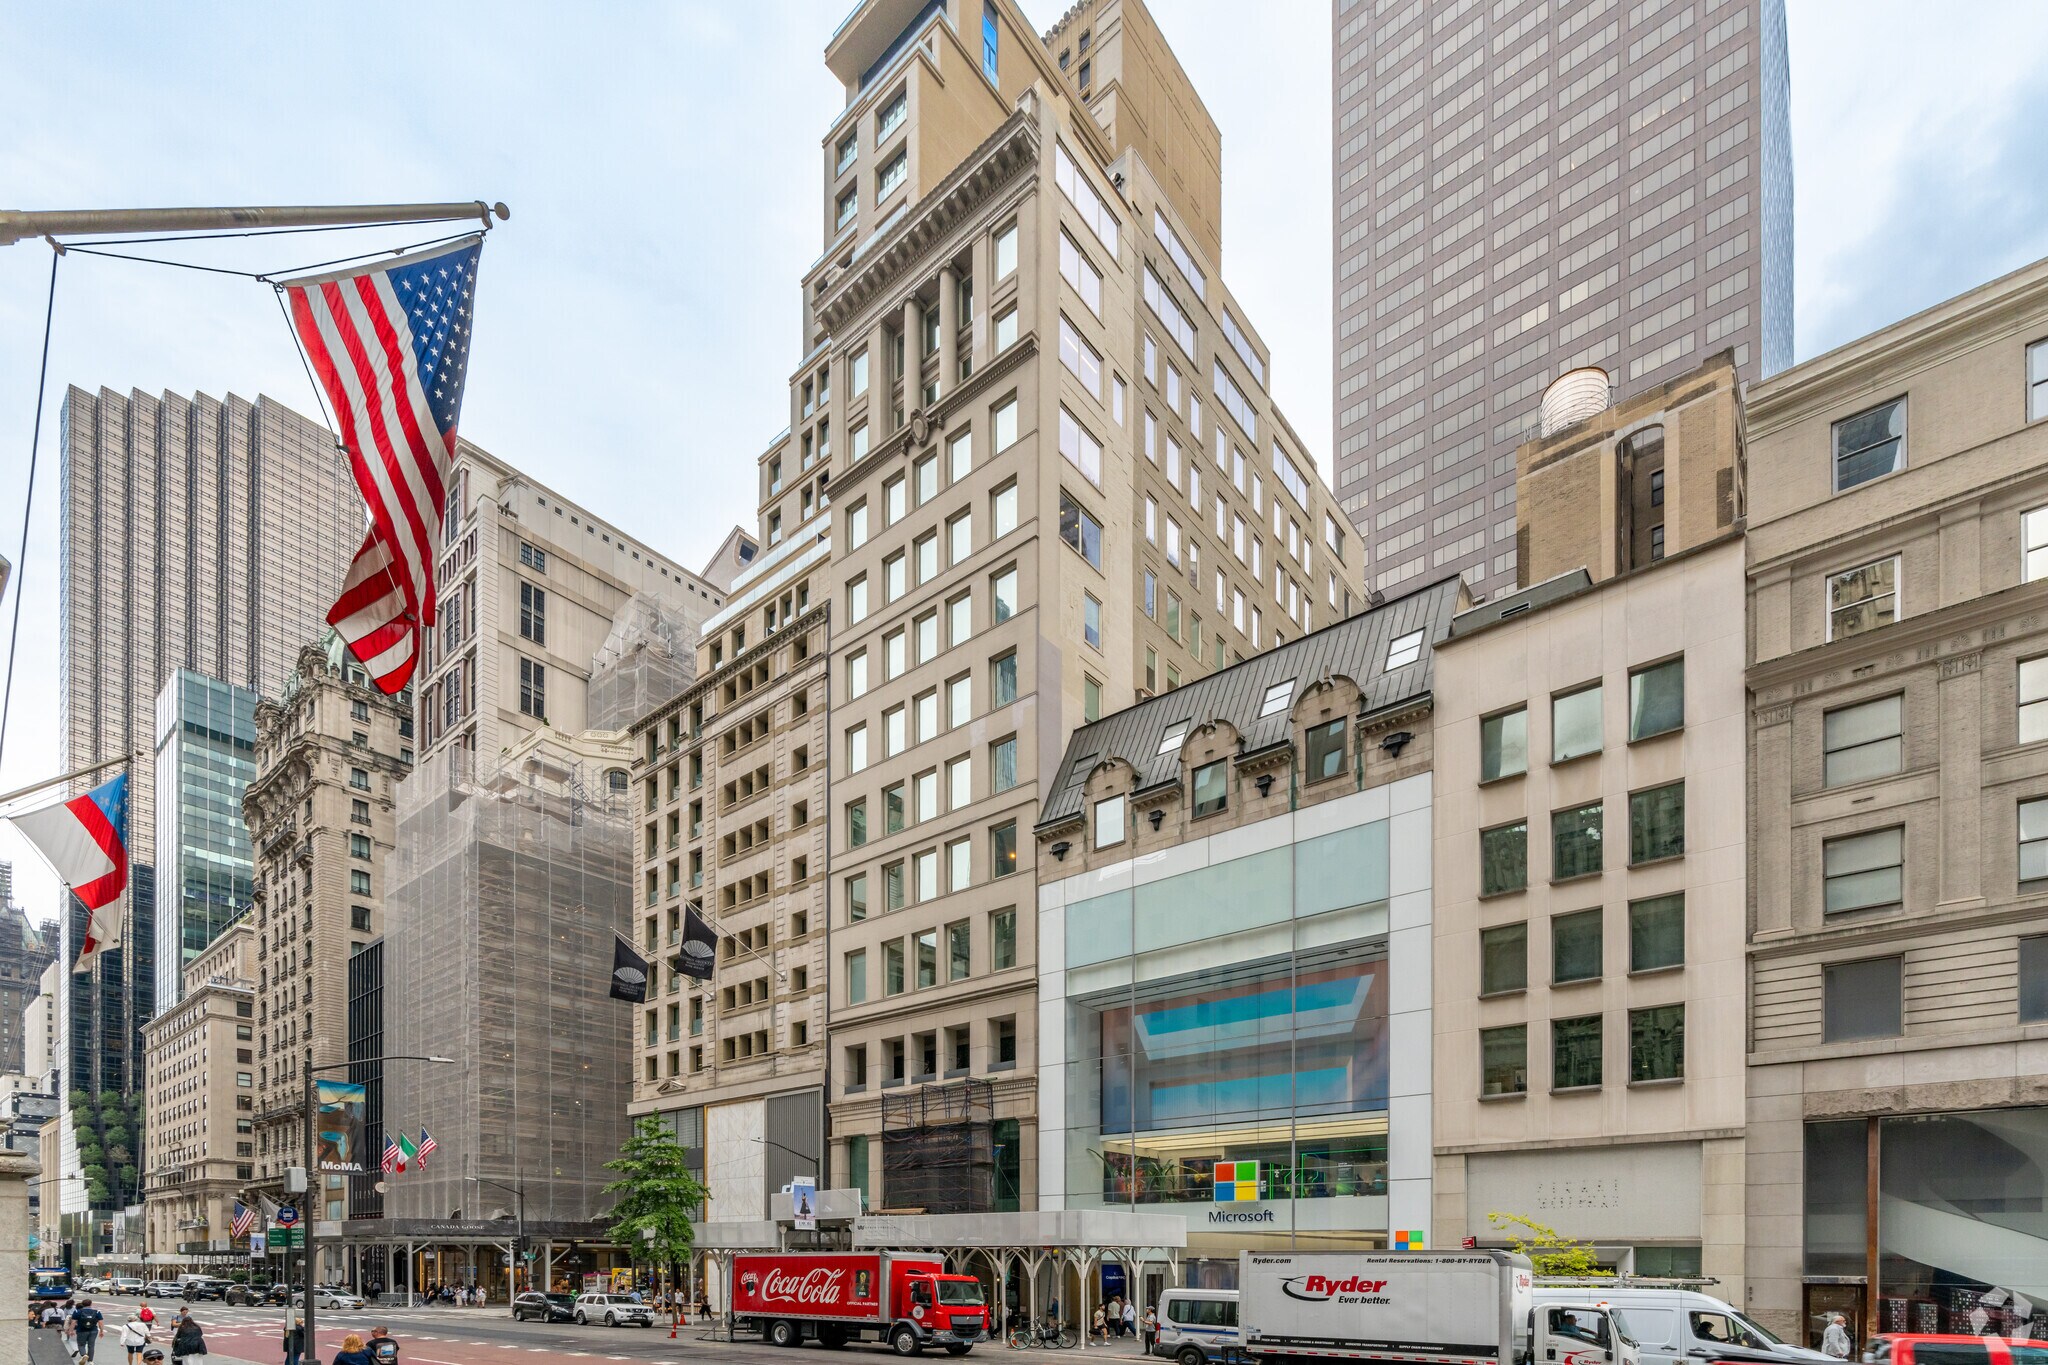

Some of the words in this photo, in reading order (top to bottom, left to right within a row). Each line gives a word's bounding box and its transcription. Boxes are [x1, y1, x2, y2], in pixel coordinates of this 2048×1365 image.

[321, 1161, 362, 1171] MoMA
[1208, 1210, 1274, 1223] Microsoft
[761, 1268, 846, 1304] Coca-Cola
[1305, 1275, 1387, 1296] Ryder
[1338, 1296, 1359, 1304] Ever
[1360, 1296, 1390, 1305] better.
